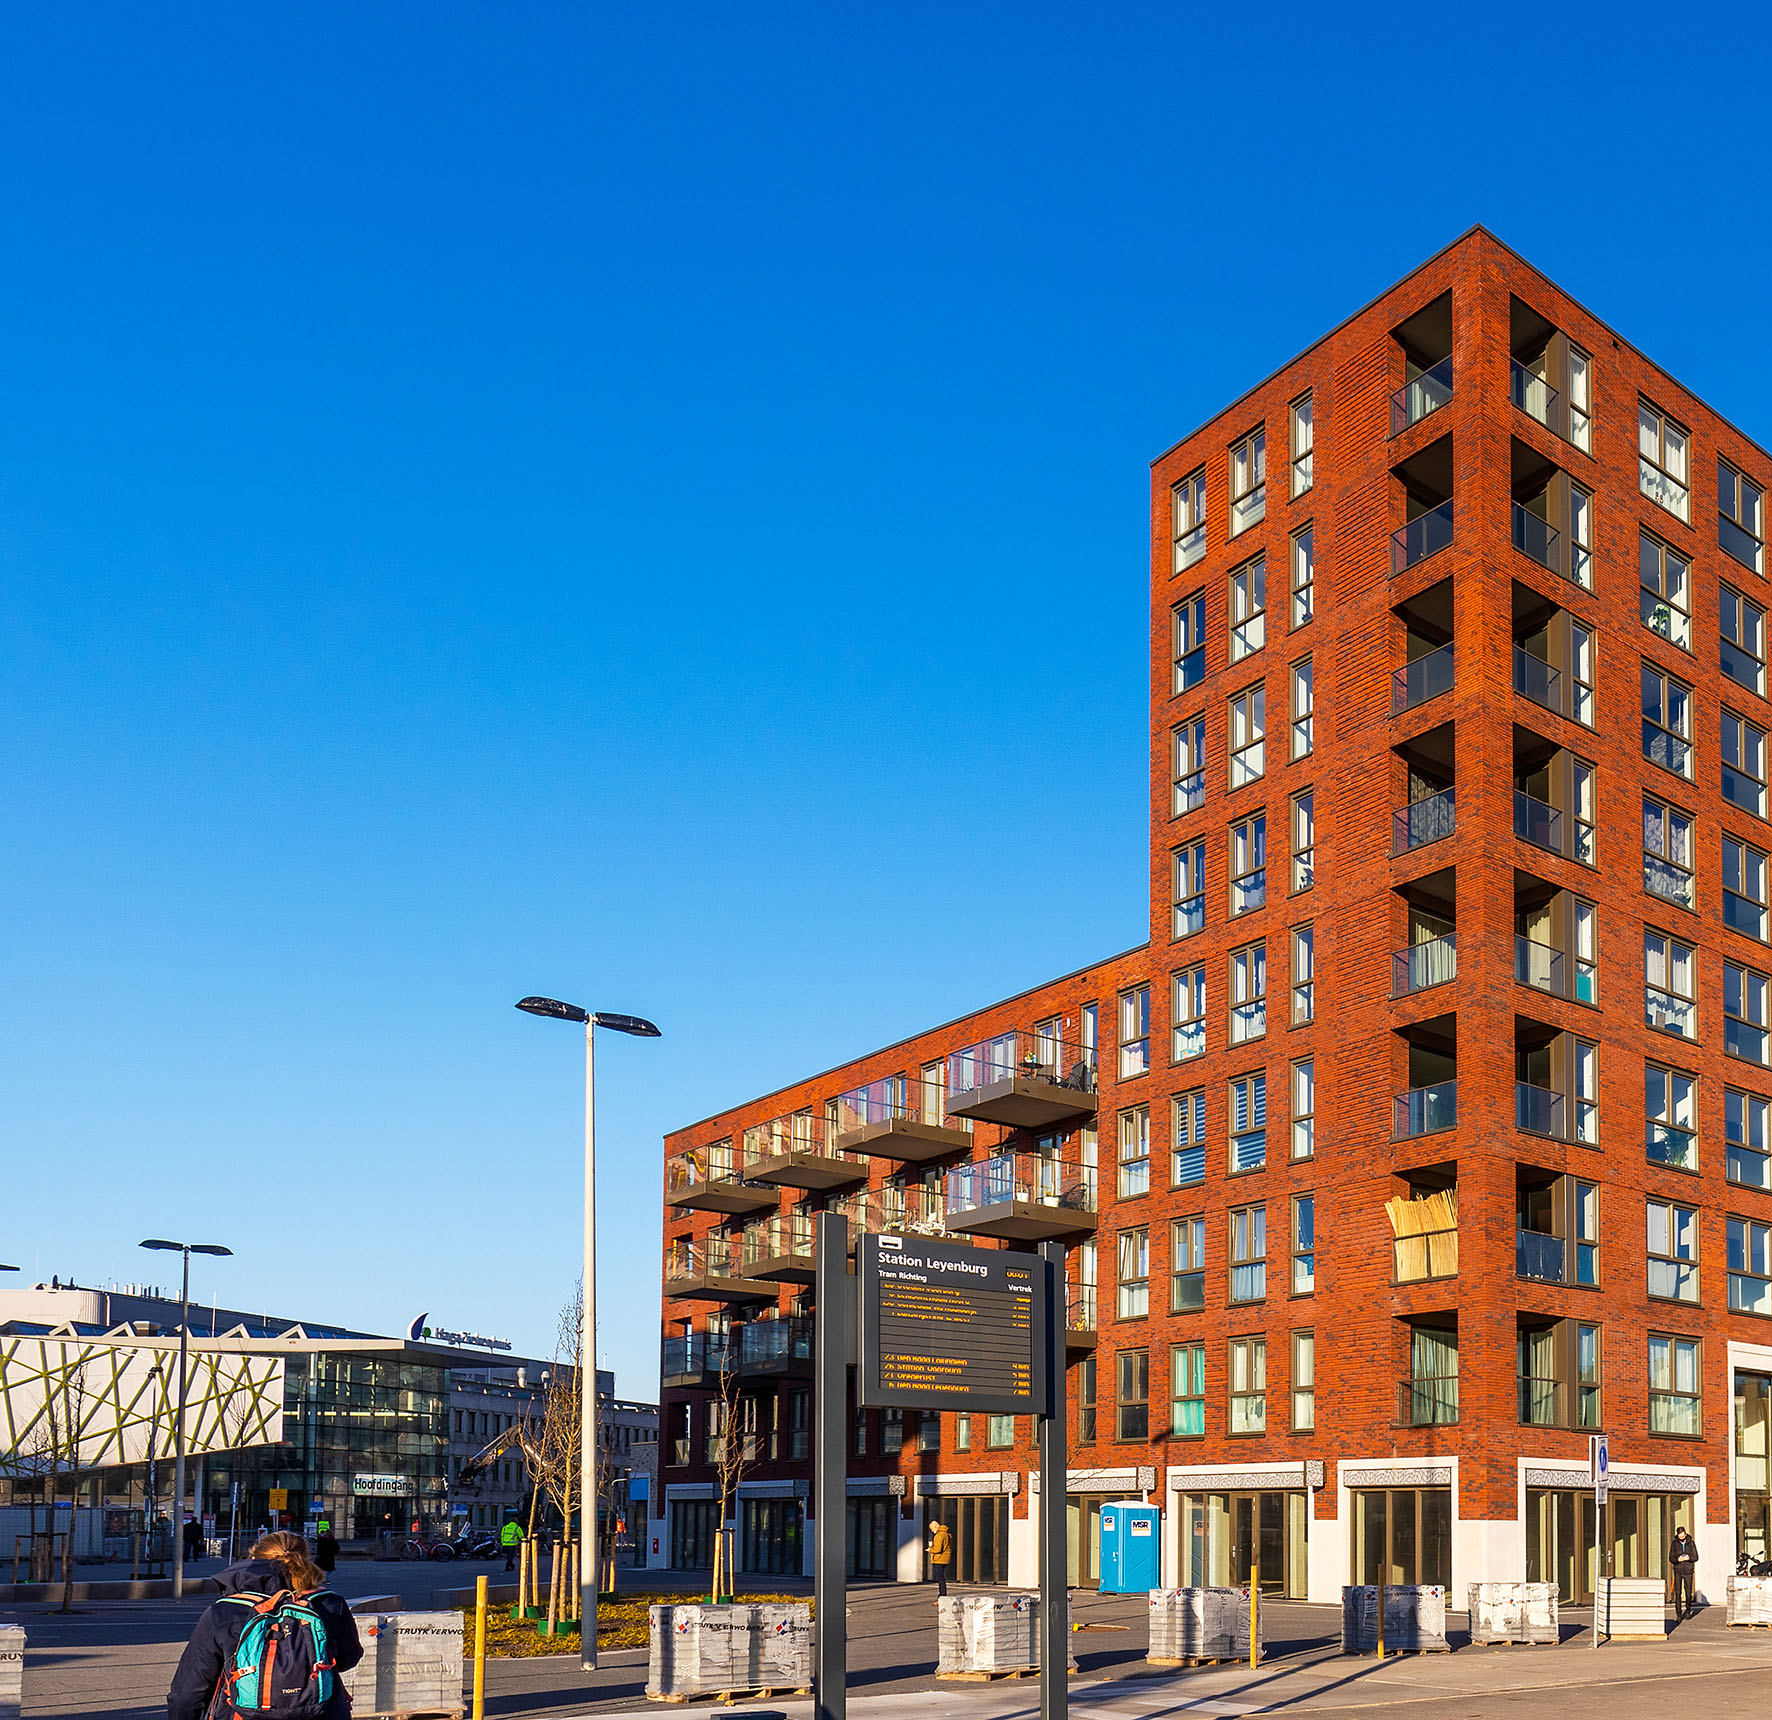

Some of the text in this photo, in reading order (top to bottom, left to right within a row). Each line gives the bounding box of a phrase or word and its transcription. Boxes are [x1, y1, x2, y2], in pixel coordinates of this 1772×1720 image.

[878, 1251, 989, 1278] Station Leyenburg
[878, 1270, 928, 1284] Tram Richting
[1008, 1284, 1033, 1294] Vertrek
[354, 1478, 414, 1493] Hoofdingang
[392, 1628, 464, 1636] STRUYK VERWO
